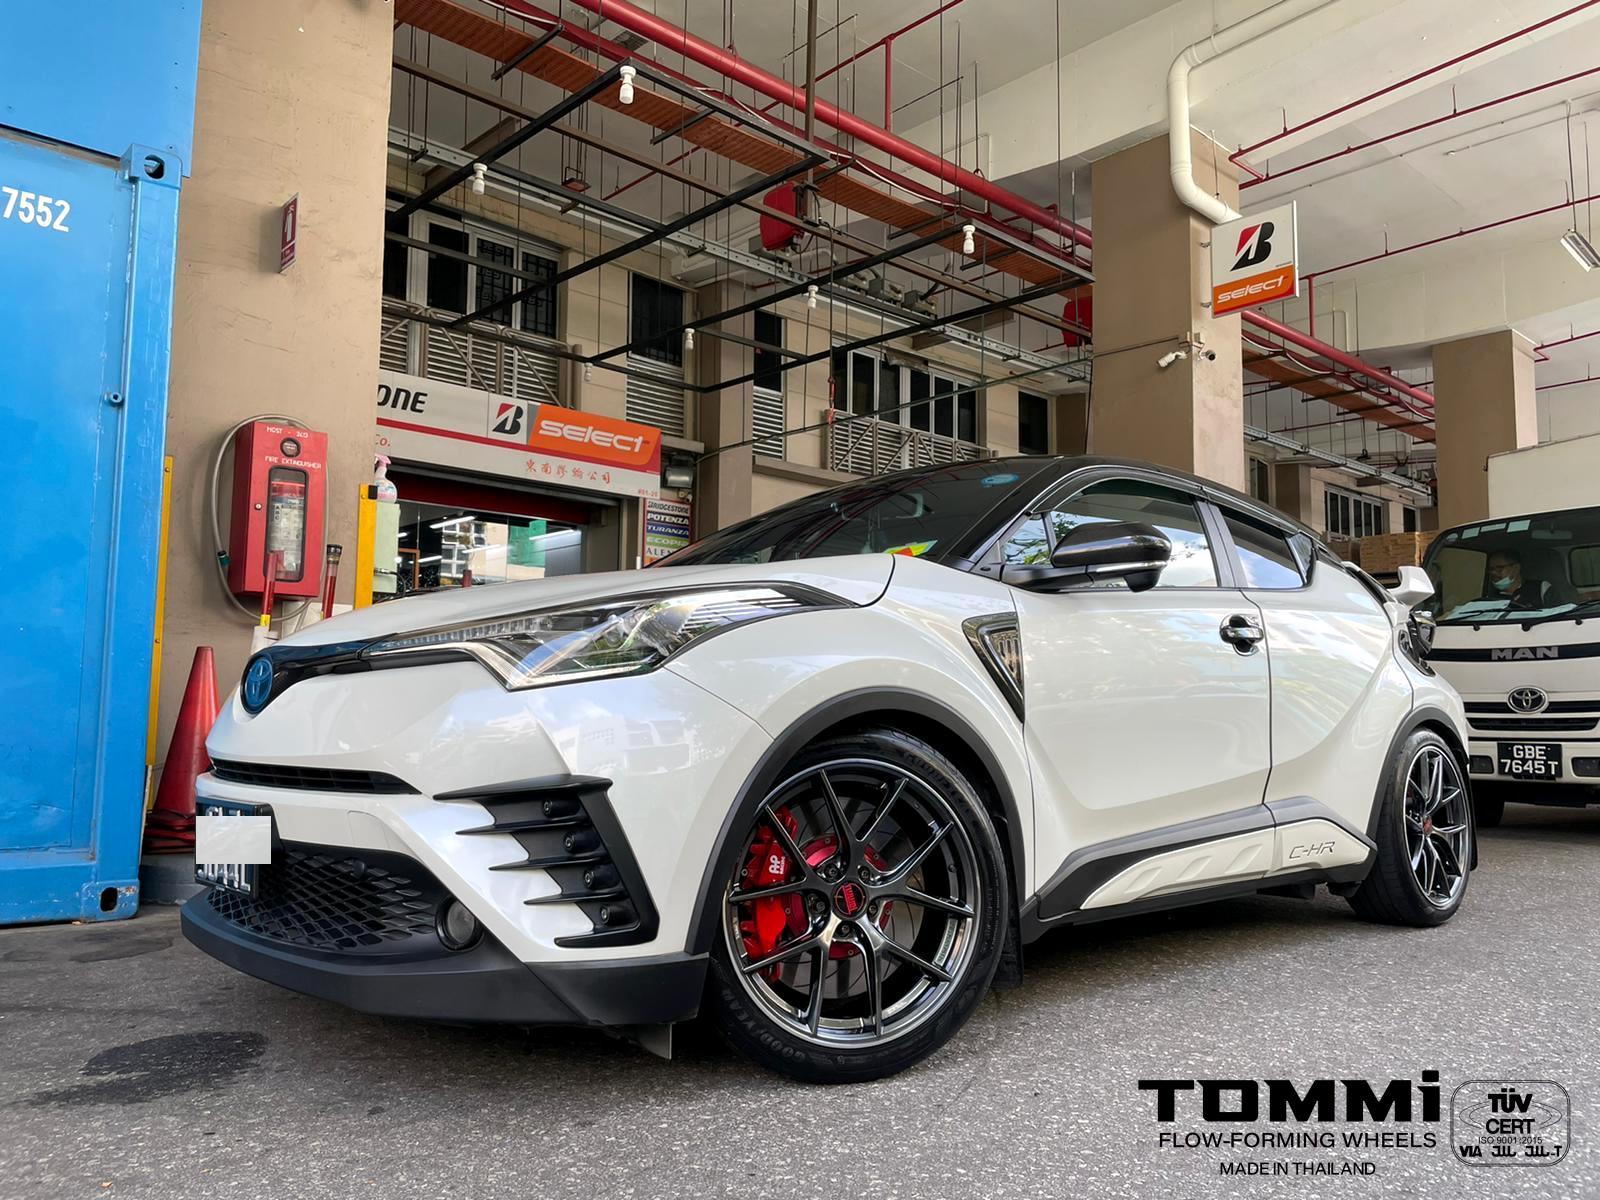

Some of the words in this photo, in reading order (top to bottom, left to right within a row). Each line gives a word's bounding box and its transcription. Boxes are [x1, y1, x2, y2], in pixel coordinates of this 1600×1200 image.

[2, 186, 71, 233] 7552
[647, 512, 689, 525] POTENZA
[647, 524, 689, 536] TURANZA
[1491, 647, 1559, 661] MAN
[1513, 745, 1547, 760] GBE
[1289, 841, 1335, 859] C-HR
